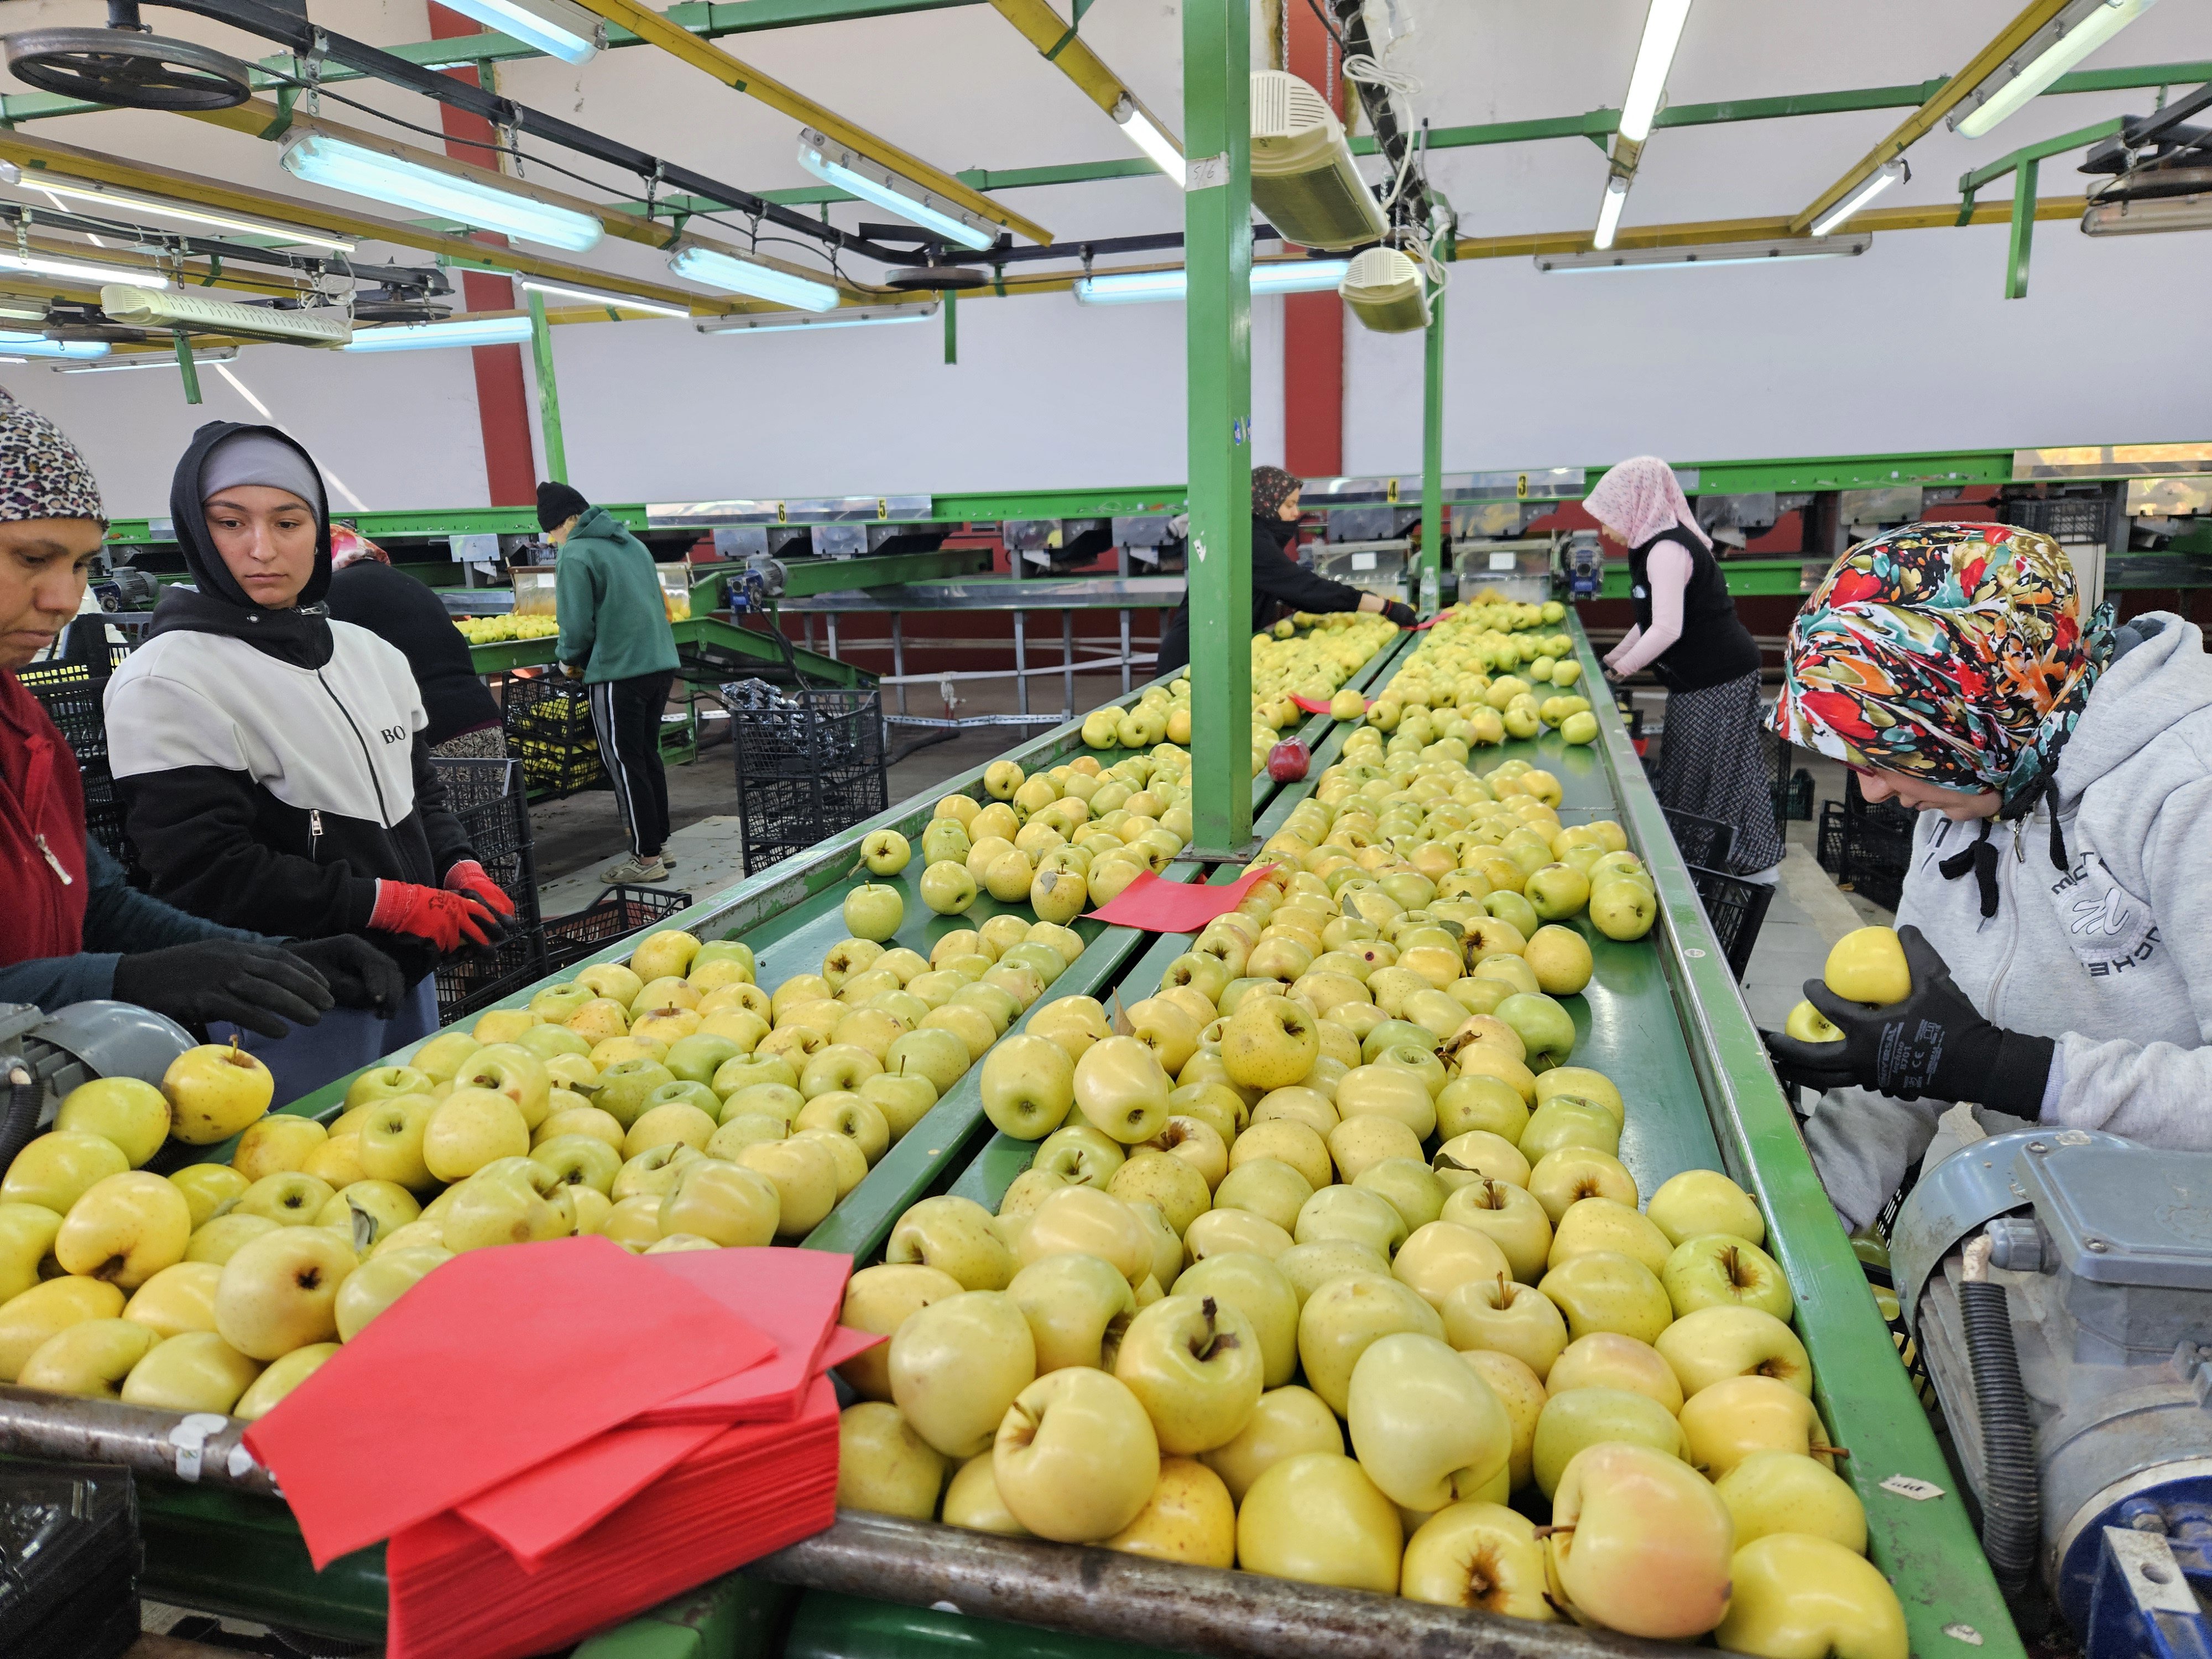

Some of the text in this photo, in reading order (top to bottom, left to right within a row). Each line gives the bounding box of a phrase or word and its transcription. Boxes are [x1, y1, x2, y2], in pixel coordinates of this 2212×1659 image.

[1389, 481, 1396, 500] 4
[1518, 476, 1526, 496] 3
[778, 504, 786, 522] 6
[879, 500, 885, 518] 5
[1912, 1051, 1925, 1068] CE
